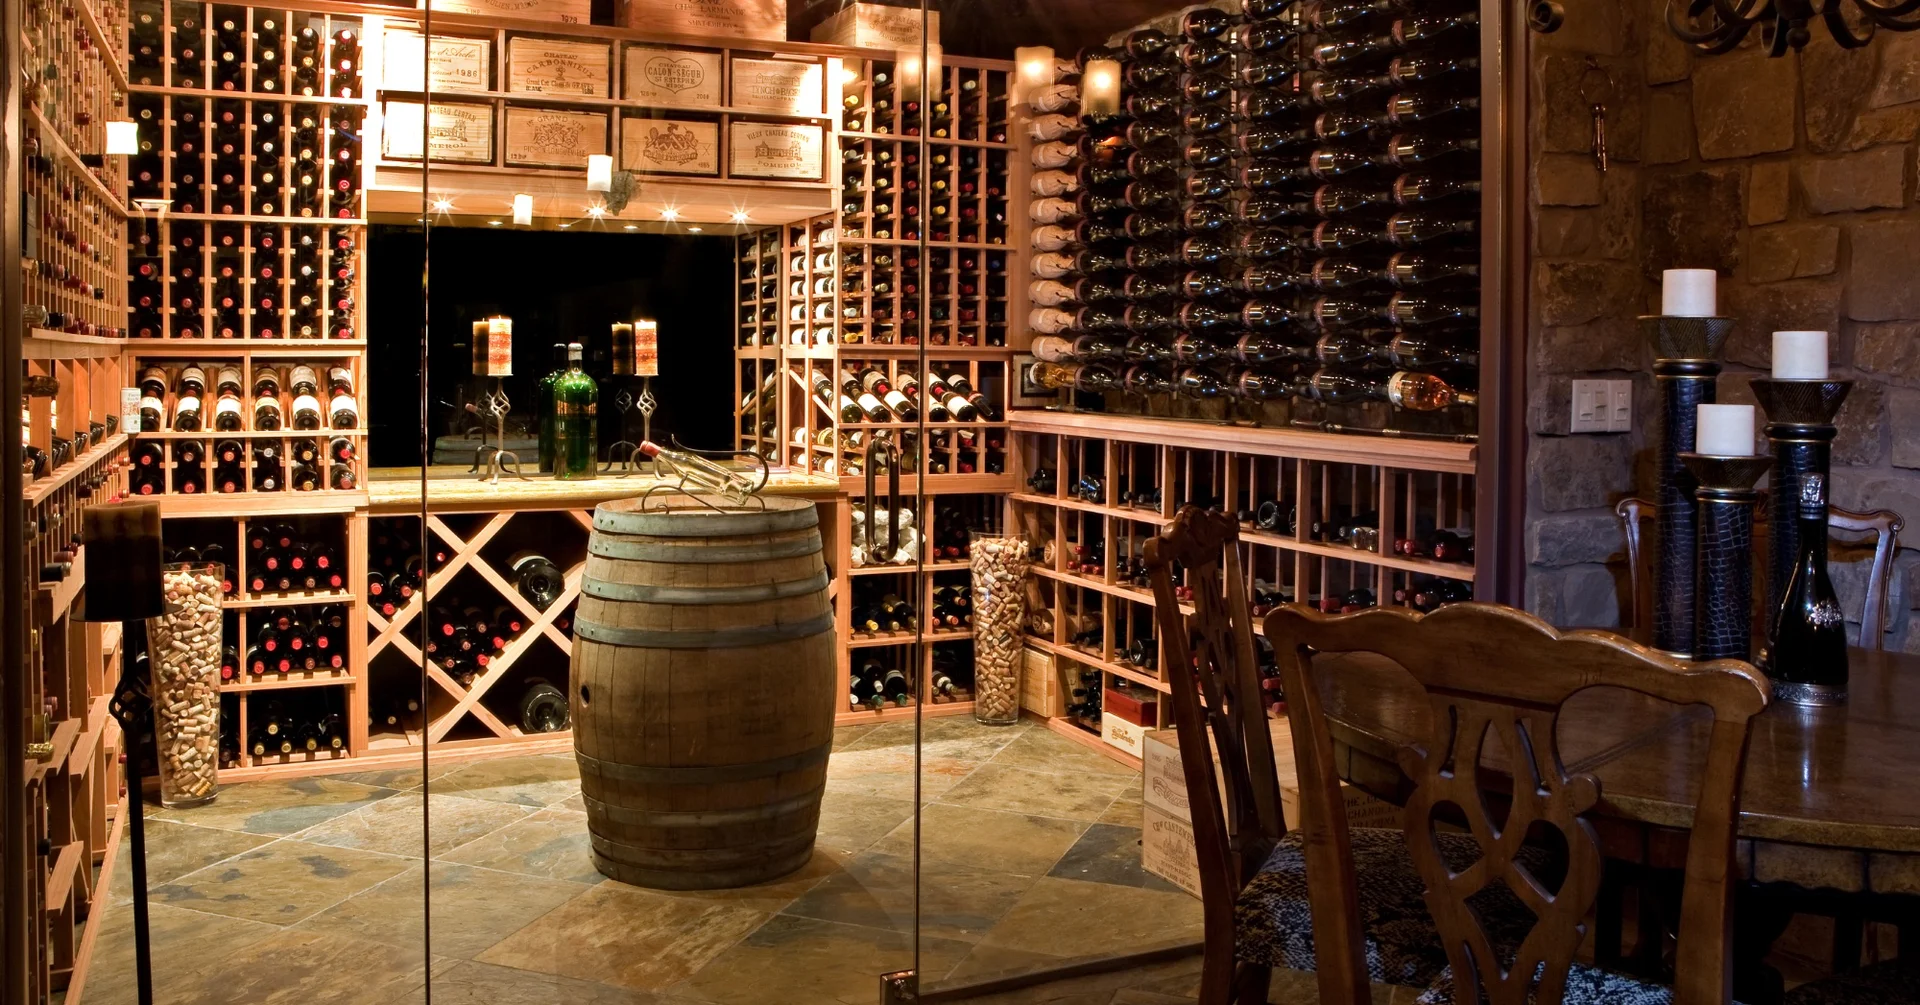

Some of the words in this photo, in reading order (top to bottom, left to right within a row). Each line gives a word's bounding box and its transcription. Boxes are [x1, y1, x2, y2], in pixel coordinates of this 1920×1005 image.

[456, 68, 478, 78] 1986
[526, 58, 595, 79] CARBONNIEUX
[752, 85, 775, 96] LYNCH
[453, 109, 477, 123] CERTAN
[537, 115, 568, 123] GRAND
[572, 119, 586, 132] VIN
[765, 129, 788, 137] CHATEAU
[757, 160, 802, 169] POMEROL
